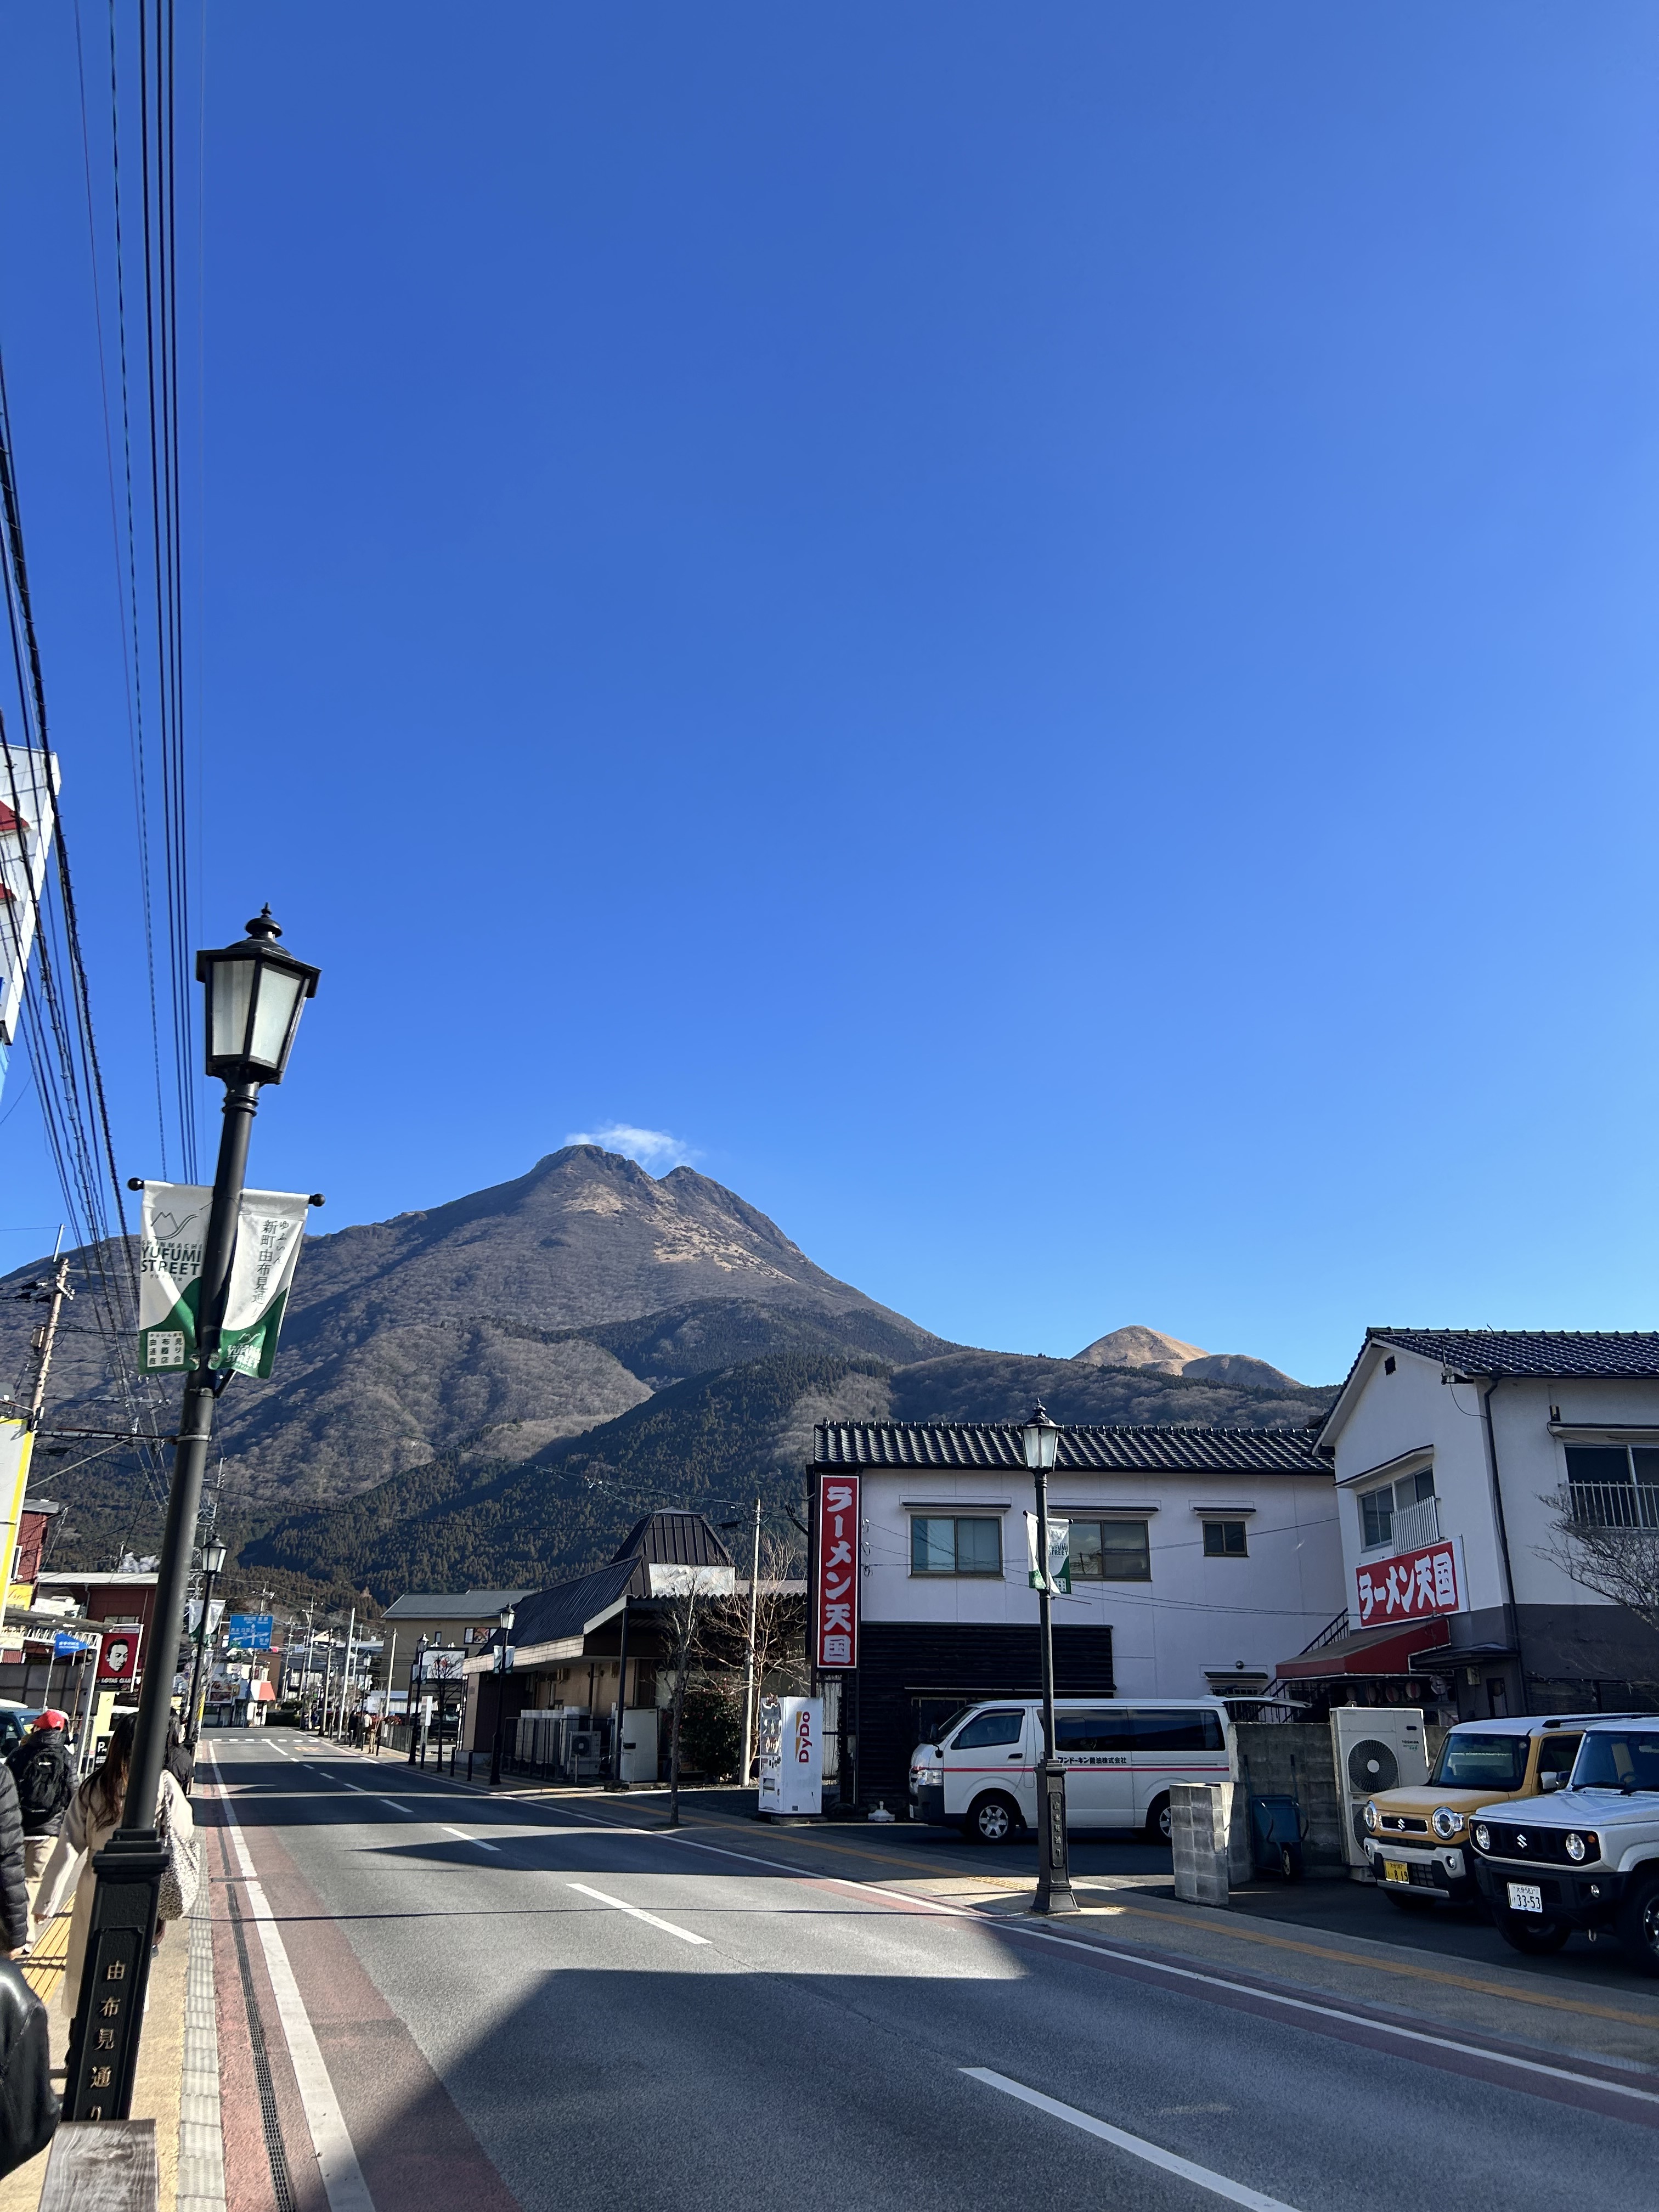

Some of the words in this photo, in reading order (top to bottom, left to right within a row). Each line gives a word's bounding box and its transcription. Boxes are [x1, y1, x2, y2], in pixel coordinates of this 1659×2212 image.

[141, 1259, 200, 1276] STREET
[142, 1246, 202, 1262] YUFUMI
[823, 1486, 853, 1663] ラーメン天国
[1359, 1551, 1455, 1620] ラーメン天国
[799, 1711, 812, 1763] DyDo
[1516, 1894, 1541, 1910] 33-53
[90, 1960, 126, 2121] 由布見通り
